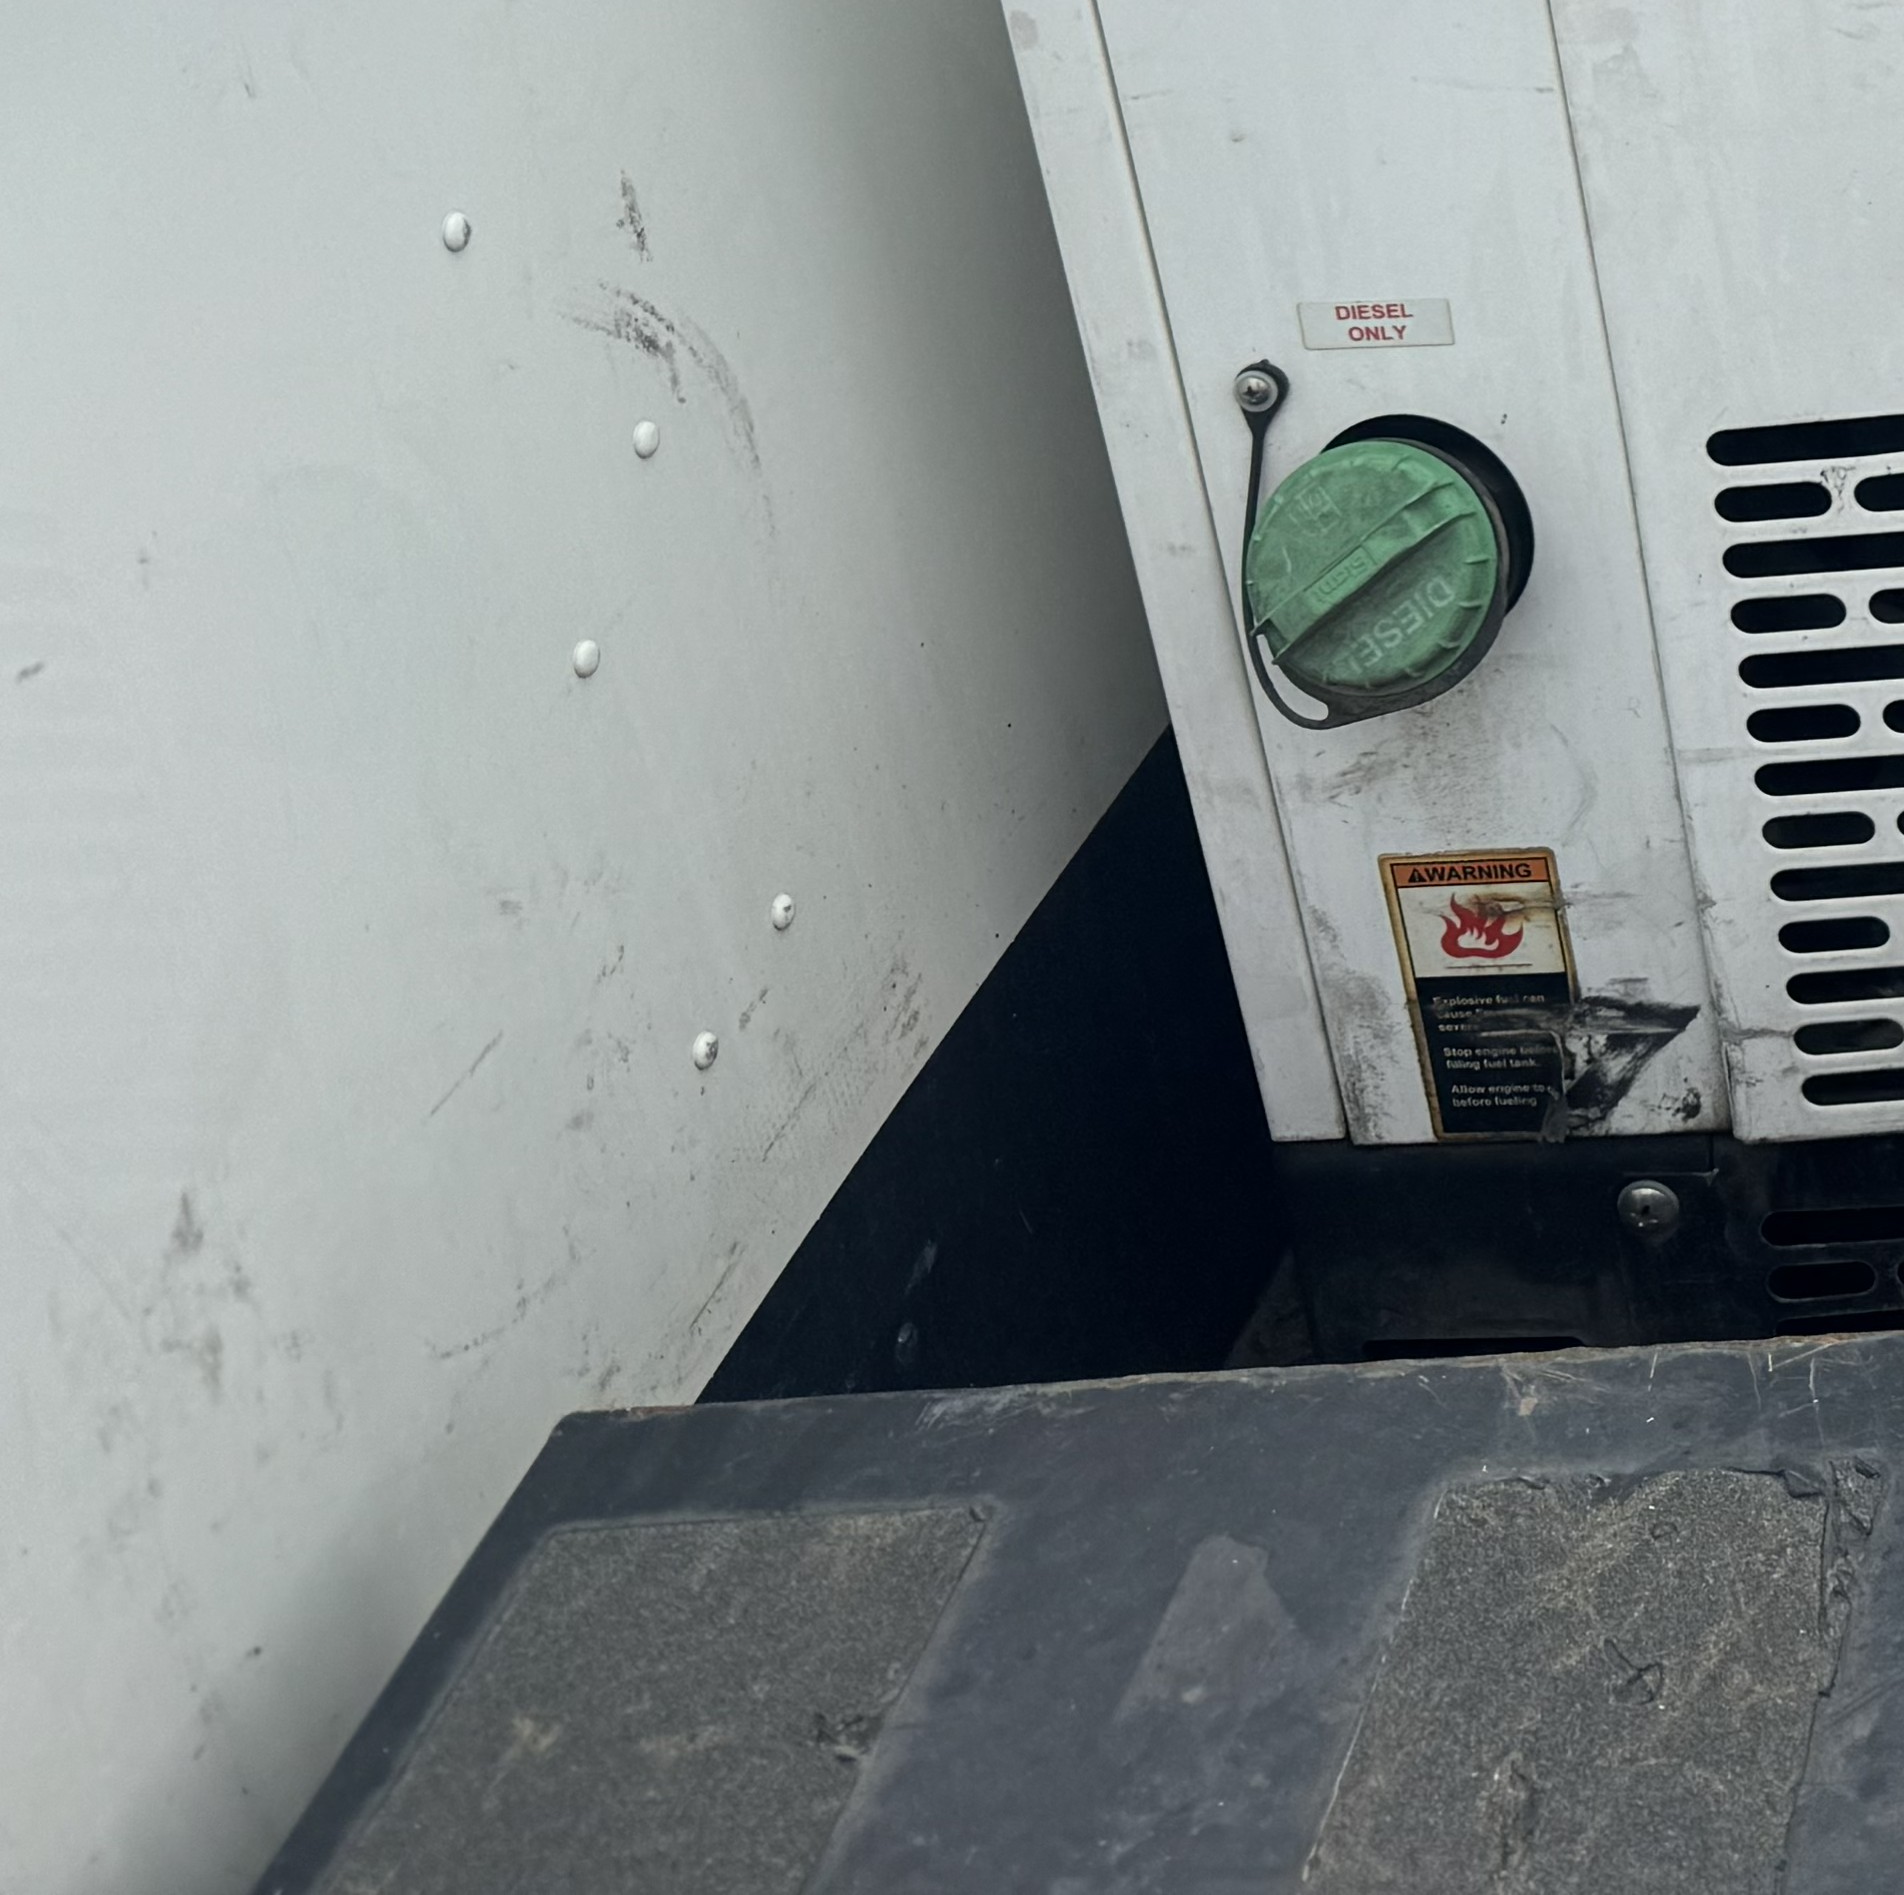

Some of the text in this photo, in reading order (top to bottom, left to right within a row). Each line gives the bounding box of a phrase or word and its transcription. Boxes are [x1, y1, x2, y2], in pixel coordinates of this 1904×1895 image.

[1335, 303, 1414, 320] DIESEL
[1348, 325, 1406, 341] ONLY
[1425, 863, 1532, 882] WARNING
[1443, 1047, 1472, 1057] Stop
[1475, 1047, 1516, 1057] engine
[1446, 1060, 1480, 1070] filling
[1483, 1058, 1506, 1068] fuel
[1451, 1084, 1485, 1094] Allow
[1488, 1083, 1530, 1094] engine
[1533, 1083, 1546, 1093] to
[1452, 1097, 1492, 1108] before
